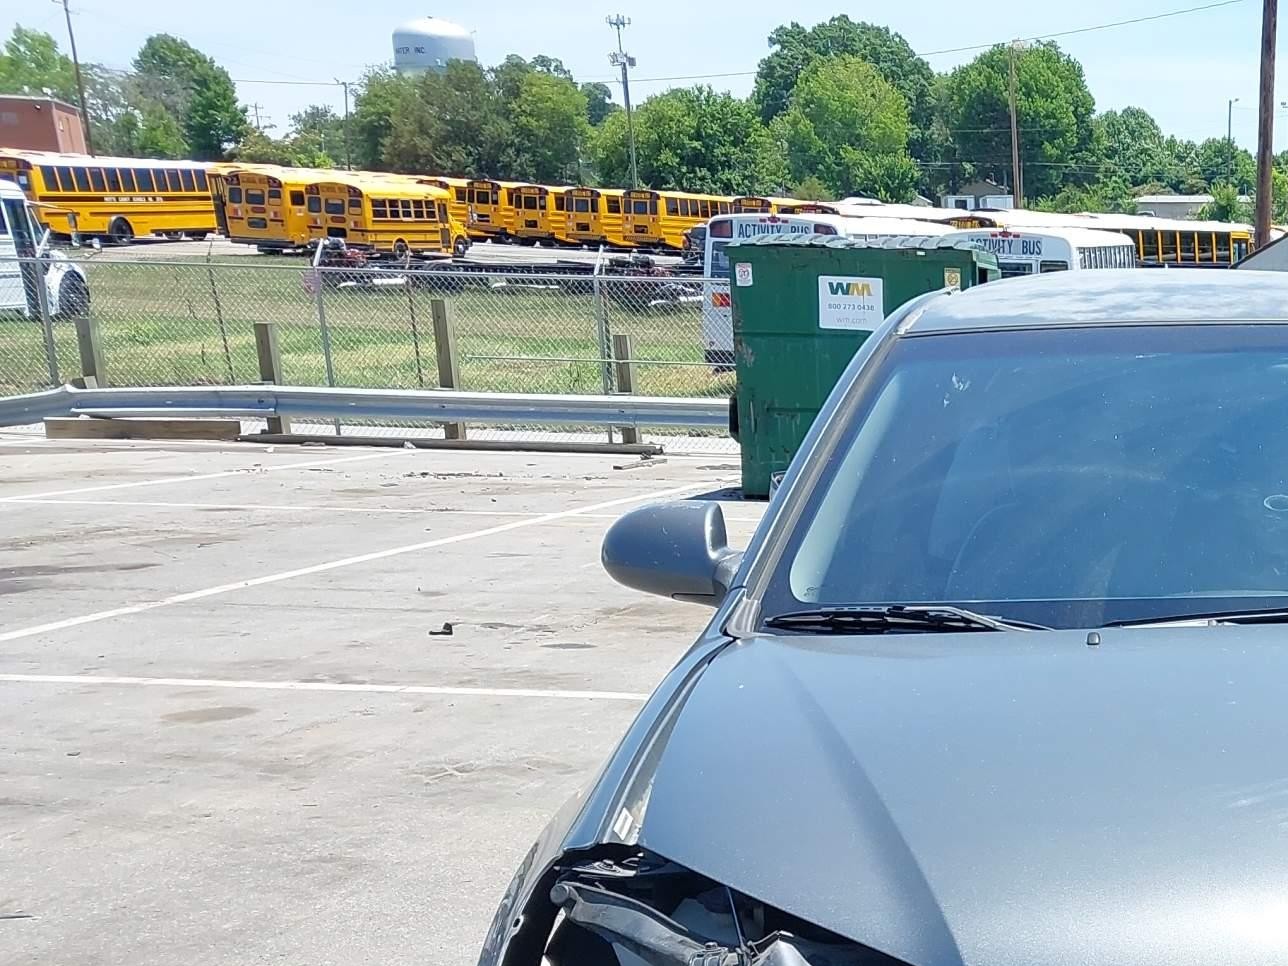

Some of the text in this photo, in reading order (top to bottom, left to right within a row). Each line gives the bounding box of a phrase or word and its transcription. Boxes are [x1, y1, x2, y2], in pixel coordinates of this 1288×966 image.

[738, 223, 782, 239] ACTIVITY
[1022, 240, 1042, 256] BUS
[828, 281, 873, 297] WM
